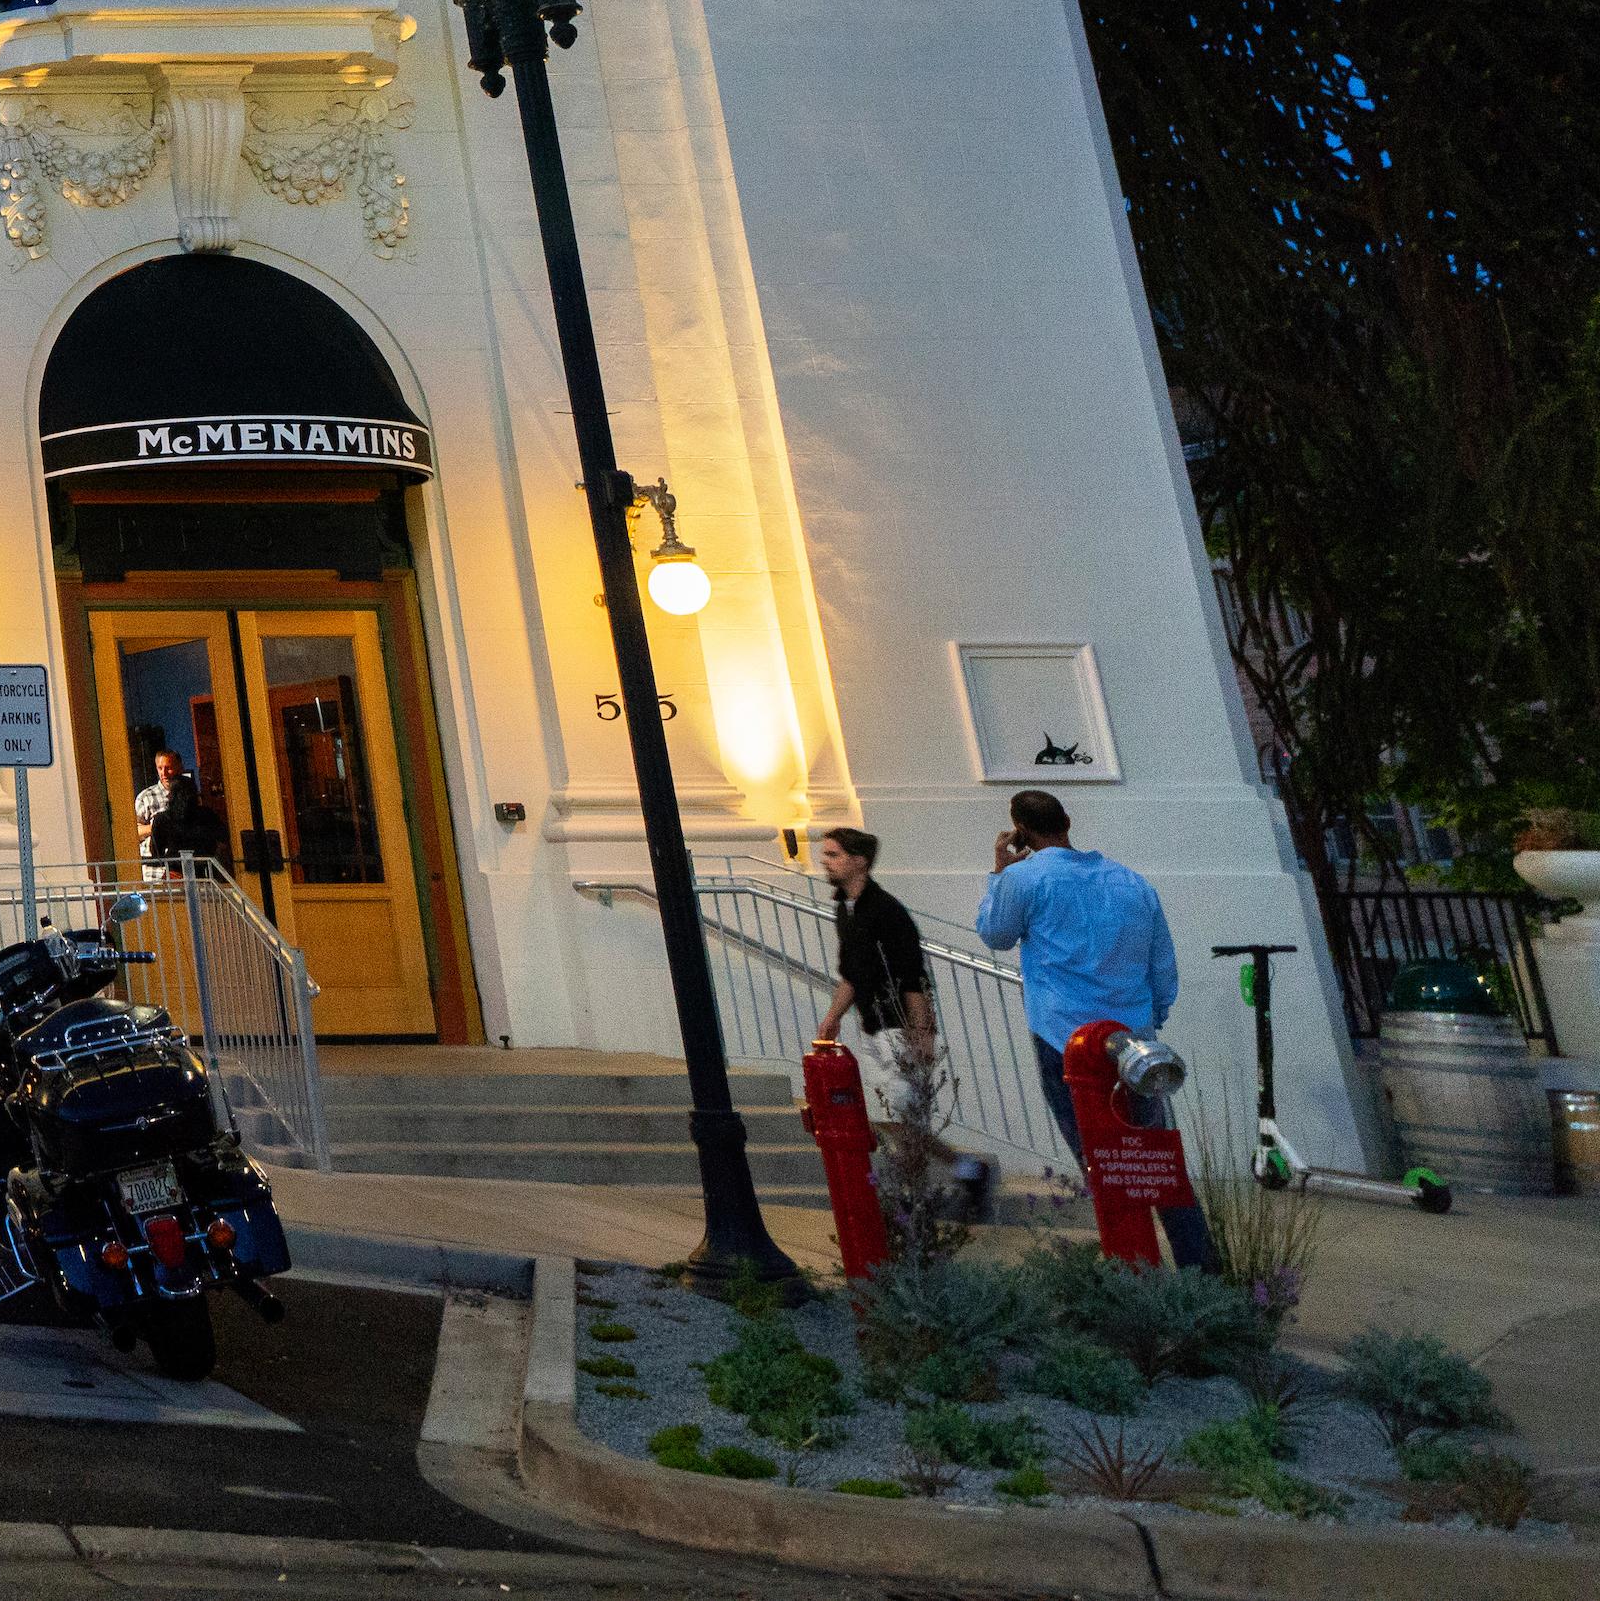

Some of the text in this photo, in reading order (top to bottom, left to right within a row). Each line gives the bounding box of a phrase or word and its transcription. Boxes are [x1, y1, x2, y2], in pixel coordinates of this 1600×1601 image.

[137, 423, 416, 459] McMENAMINS
[595, 693, 677, 721] 55
[4, 738, 32, 751] ONLY
[1120, 1150, 1176, 1160] BROADWAY
